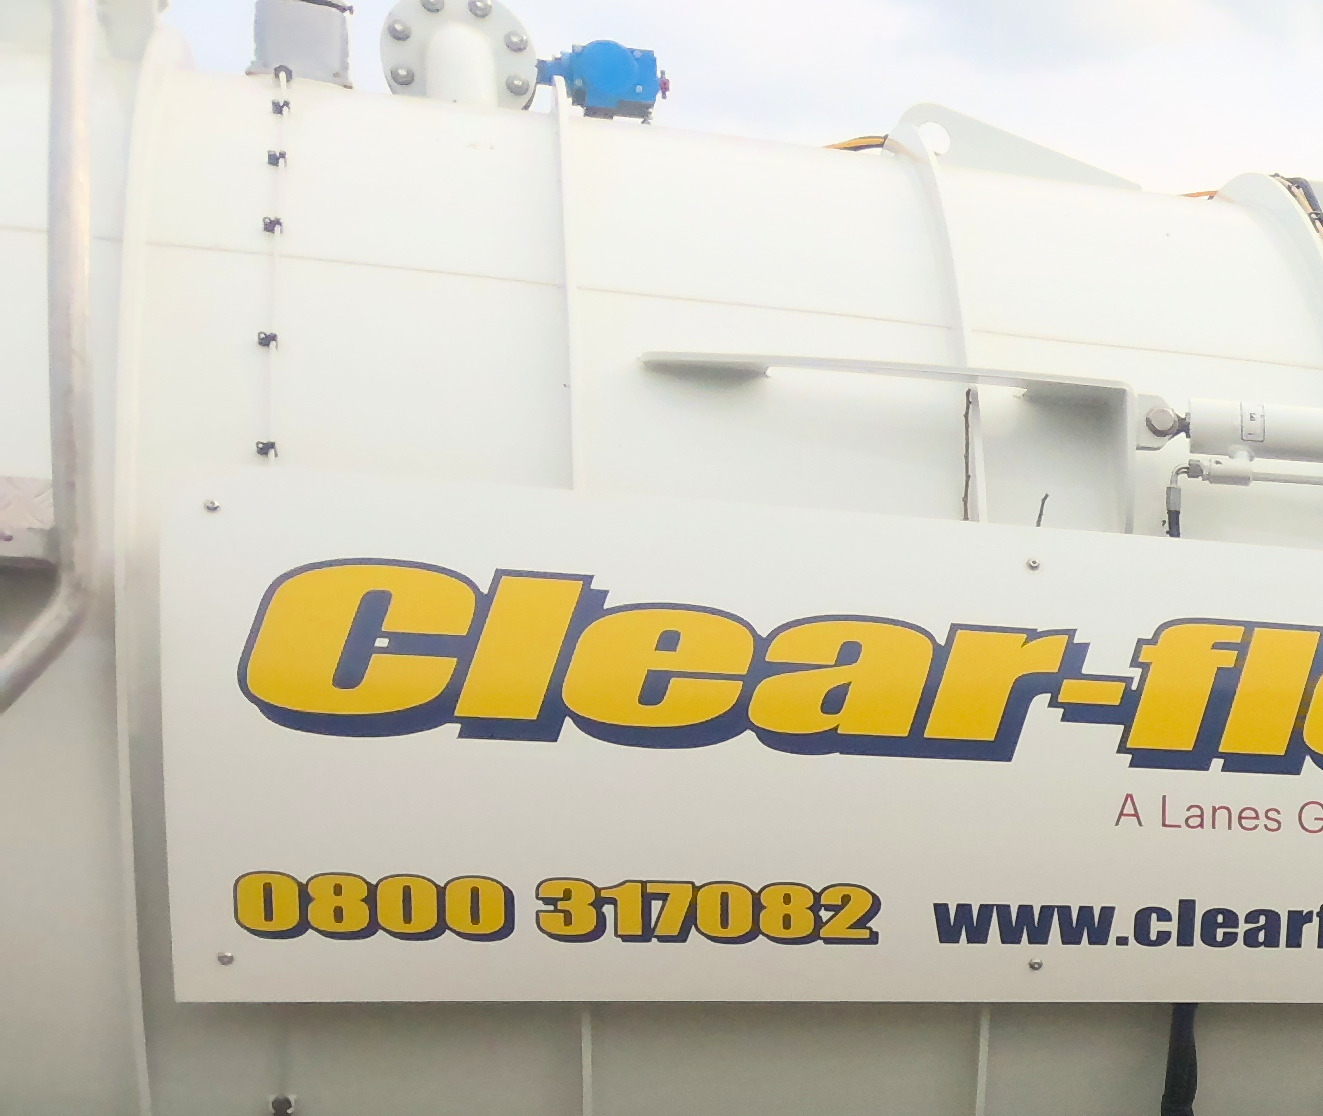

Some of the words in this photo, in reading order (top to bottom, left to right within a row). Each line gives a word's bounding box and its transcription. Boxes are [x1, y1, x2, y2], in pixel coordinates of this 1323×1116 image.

[1114, 793, 1143, 827] A
[1161, 795, 1283, 832] Lanes
[234, 870, 515, 941] 0800
[535, 877, 880, 944] 317082
